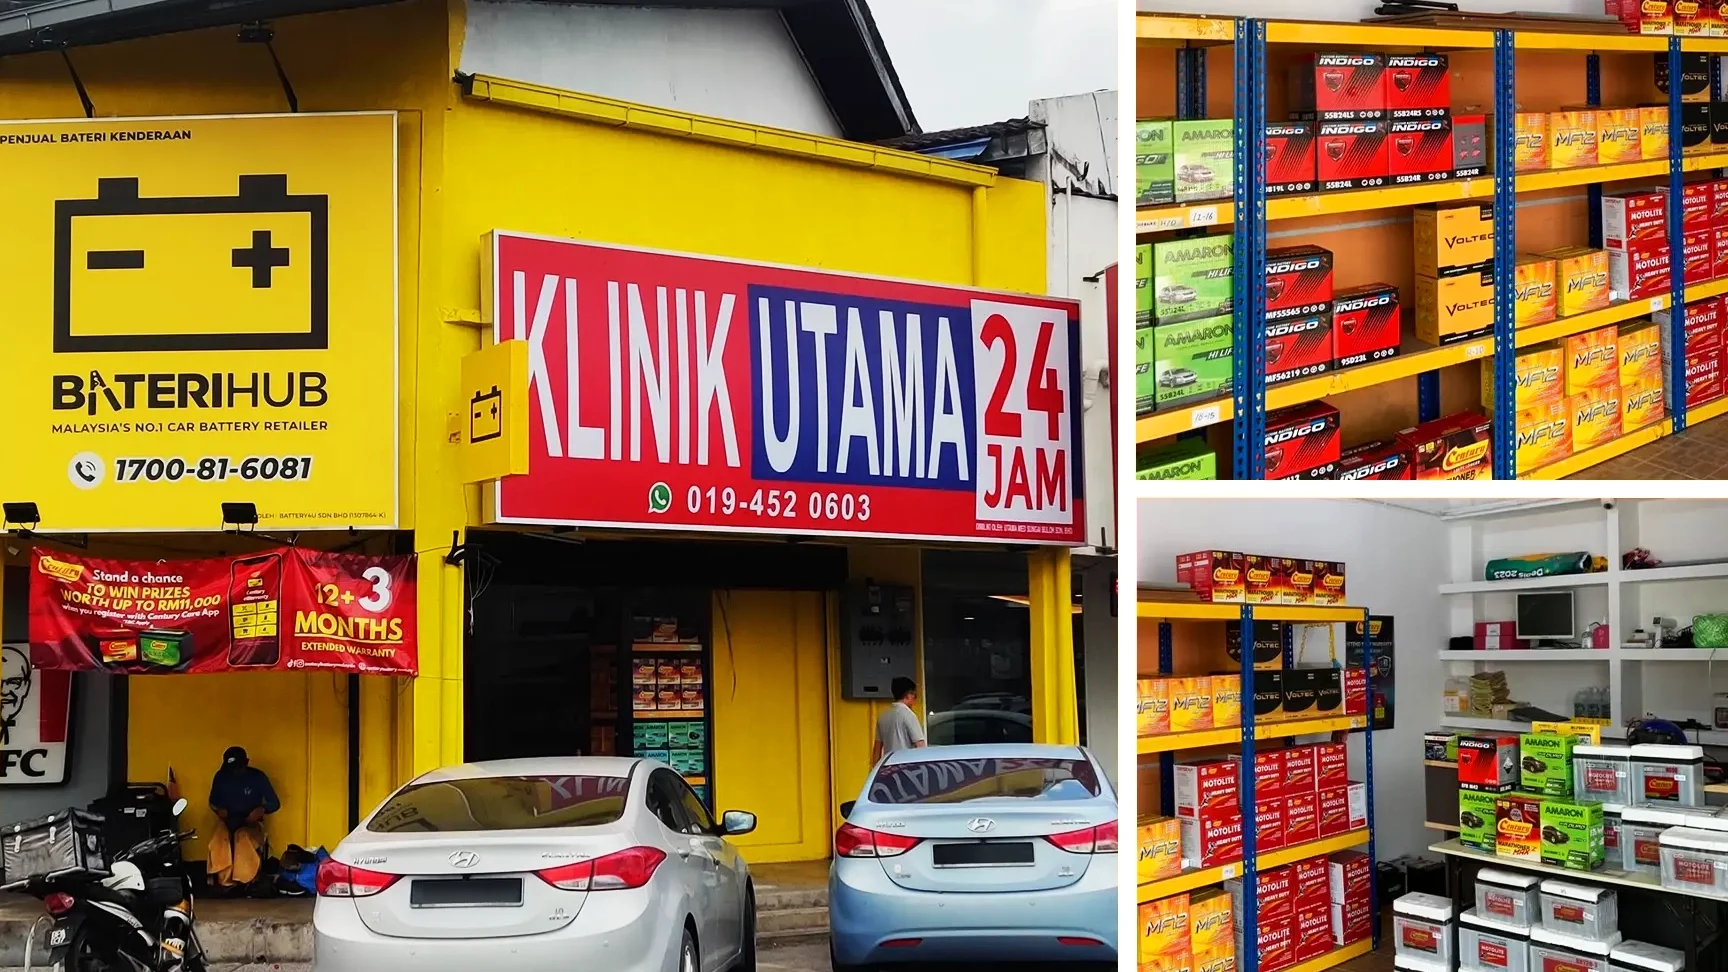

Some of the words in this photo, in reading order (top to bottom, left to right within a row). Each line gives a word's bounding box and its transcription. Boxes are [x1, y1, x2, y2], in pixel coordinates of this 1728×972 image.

[1319, 58, 1375, 66] INDIGO
[1388, 59, 1439, 67] INDIGO
[1321, 125, 1377, 135] INDIGO
[1391, 122, 1442, 132] INDIGO
[0, 134, 57, 144] PENJUAL
[60, 132, 106, 142] BATERI
[110, 130, 192, 142] KENDERAAN
[1631, 208, 1663, 220] MOTOLITE
[1635, 255, 1669, 271] MOTOLITE
[1335, 296, 1390, 313] INDIGO
[1684, 314, 1717, 327] MOTOLITE
[514, 271, 742, 469] KLINIK
[757, 297, 969, 481] UTAMA
[1685, 360, 1718, 377] MOTOLITE
[980, 314, 1065, 442] 24
[52, 423, 131, 434] MALAYSIA'S
[135, 422, 164, 433] NO.1
[167, 422, 195, 432] CAR
[199, 421, 260, 432] BATTERY
[264, 420, 328, 432] RETAILER
[1445, 444, 1486, 468] Century
[114, 456, 313, 483] 1700-81-6081
[984, 444, 1067, 512] JAM
[687, 486, 798, 519] 019-452
[809, 495, 872, 521] 0603
[92, 569, 129, 582] Stand
[141, 572, 183, 583] chance
[87, 583, 106, 596] TO
[109, 586, 138, 599] WIN
[142, 586, 190, 599] PRIZES
[61, 589, 110, 608] WORTH
[113, 598, 132, 610] UP
[136, 600, 155, 611] TO
[158, 595, 221, 611] RM11,000
[79, 606, 93, 615] you
[94, 609, 125, 619] register
[127, 612, 146, 620] with
[148, 610, 181, 621] Century
[202, 608, 220, 617] App
[294, 611, 403, 641] MONTHS
[301, 642, 345, 653] EXTENDED
[346, 645, 396, 657] WARRANTY
[1460, 740, 1490, 749] INDIGO
[1525, 738, 1560, 748] AMARON
[1203, 776, 1235, 788] MOTOLITE
[1545, 806, 1584, 819] AMARON
[1207, 823, 1241, 839] MOTOLITE
[1298, 867, 1325, 880] MOTOLITE
[1256, 879, 1289, 895] MOTOLITE
[1300, 914, 1327, 929] MOTOLITE
[1257, 927, 1290, 945] MOTOLITE
